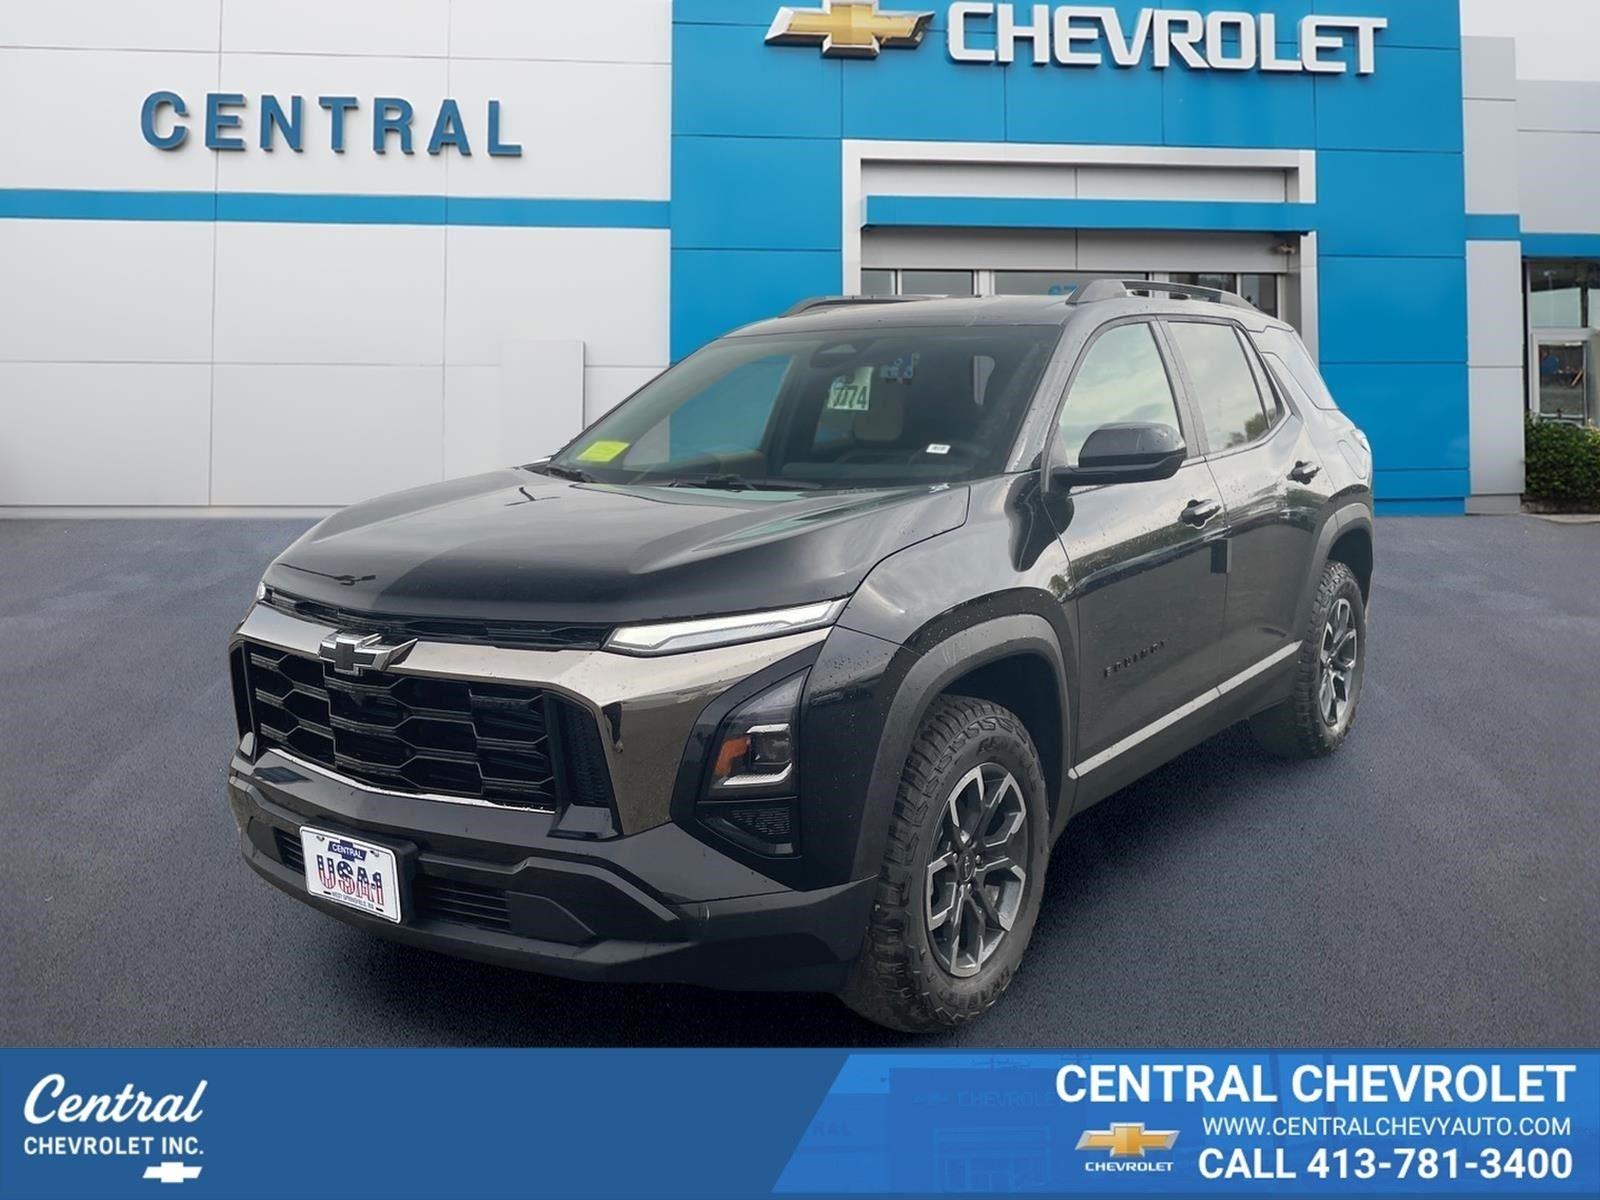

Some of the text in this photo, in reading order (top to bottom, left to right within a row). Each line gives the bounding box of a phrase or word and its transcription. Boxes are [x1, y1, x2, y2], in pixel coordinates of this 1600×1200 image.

[947, 1, 1388, 75] CHEVROLET
[140, 90, 523, 158] CENTRAL
[331, 843, 364, 860] CENTRAL
